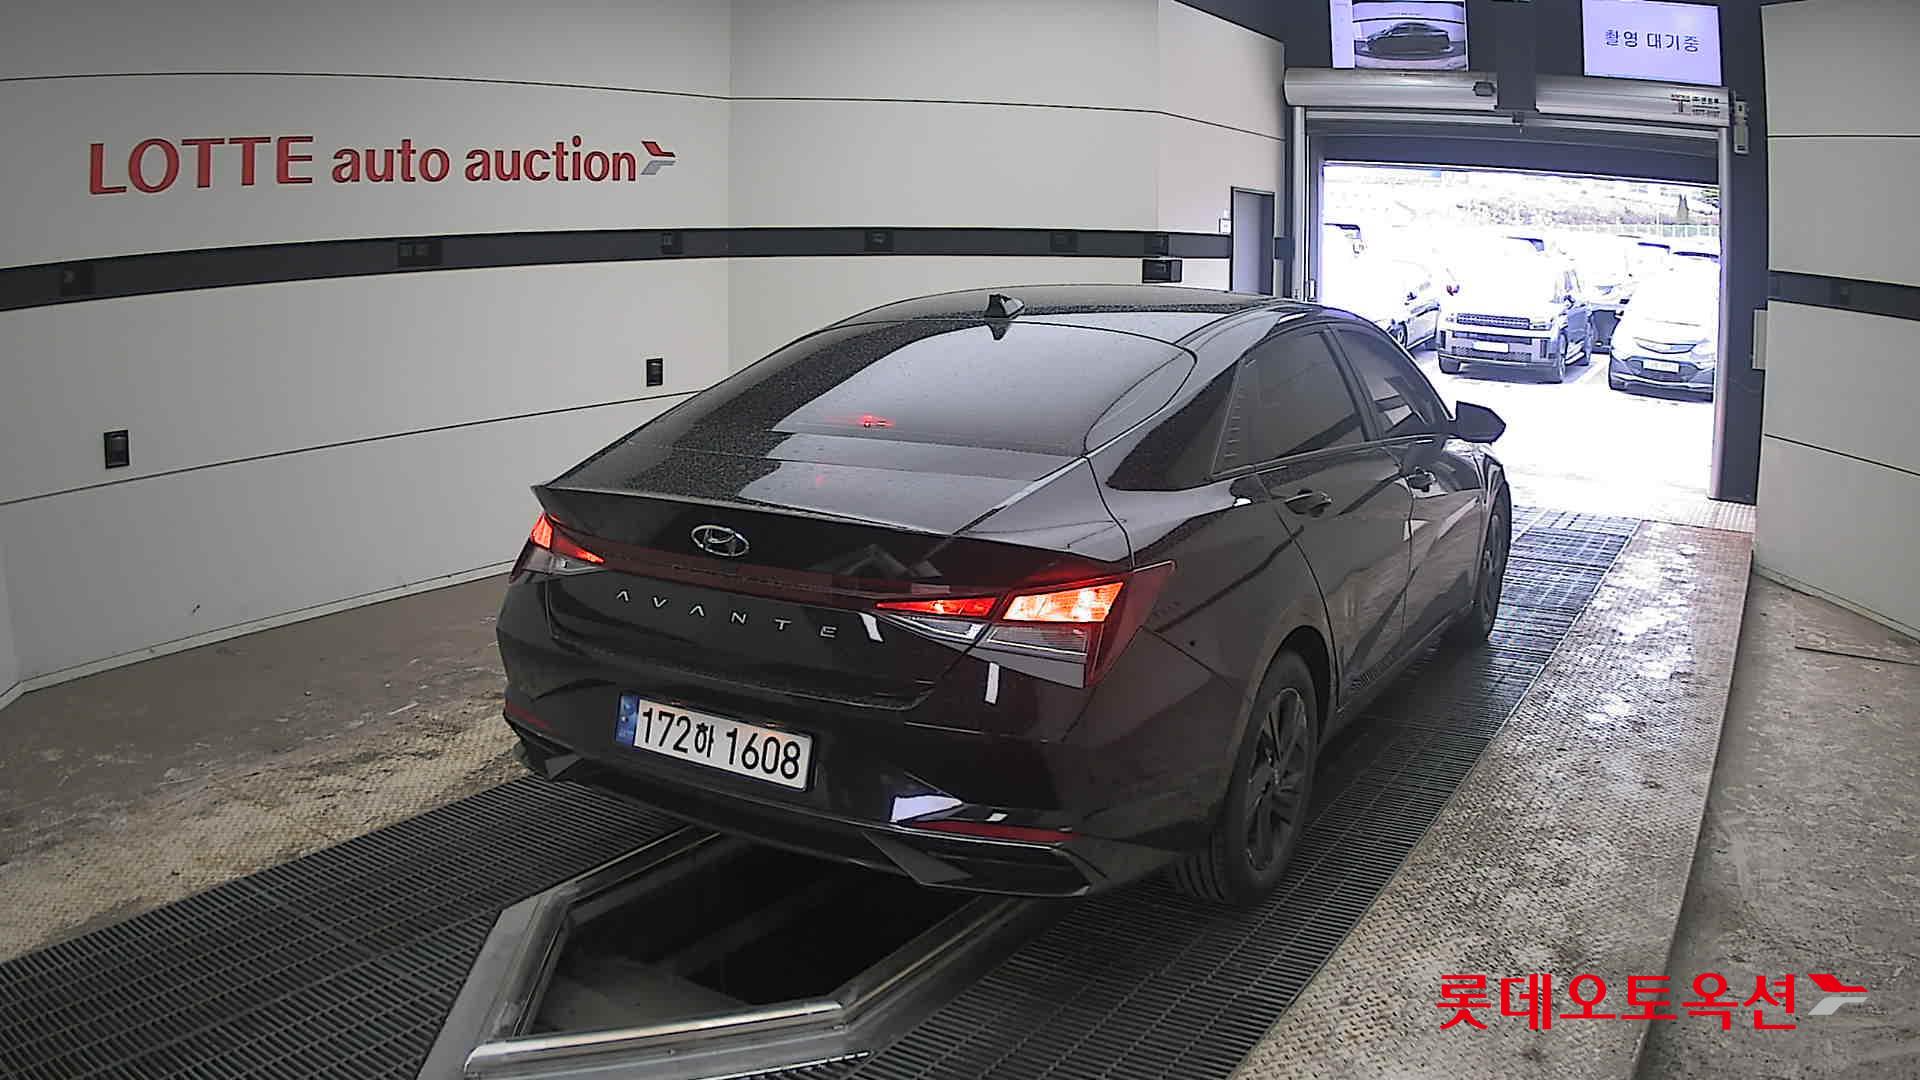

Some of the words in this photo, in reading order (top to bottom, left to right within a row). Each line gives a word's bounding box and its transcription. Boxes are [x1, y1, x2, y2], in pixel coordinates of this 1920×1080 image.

[1646, 32, 1699, 53] 대기중
[89, 136, 314, 194] LOTTE
[332, 139, 450, 183] auto
[465, 136, 638, 183] auction
[616, 590, 838, 638] AVANTE
[642, 707, 714, 758] 172하
[726, 727, 801, 780] 1608
